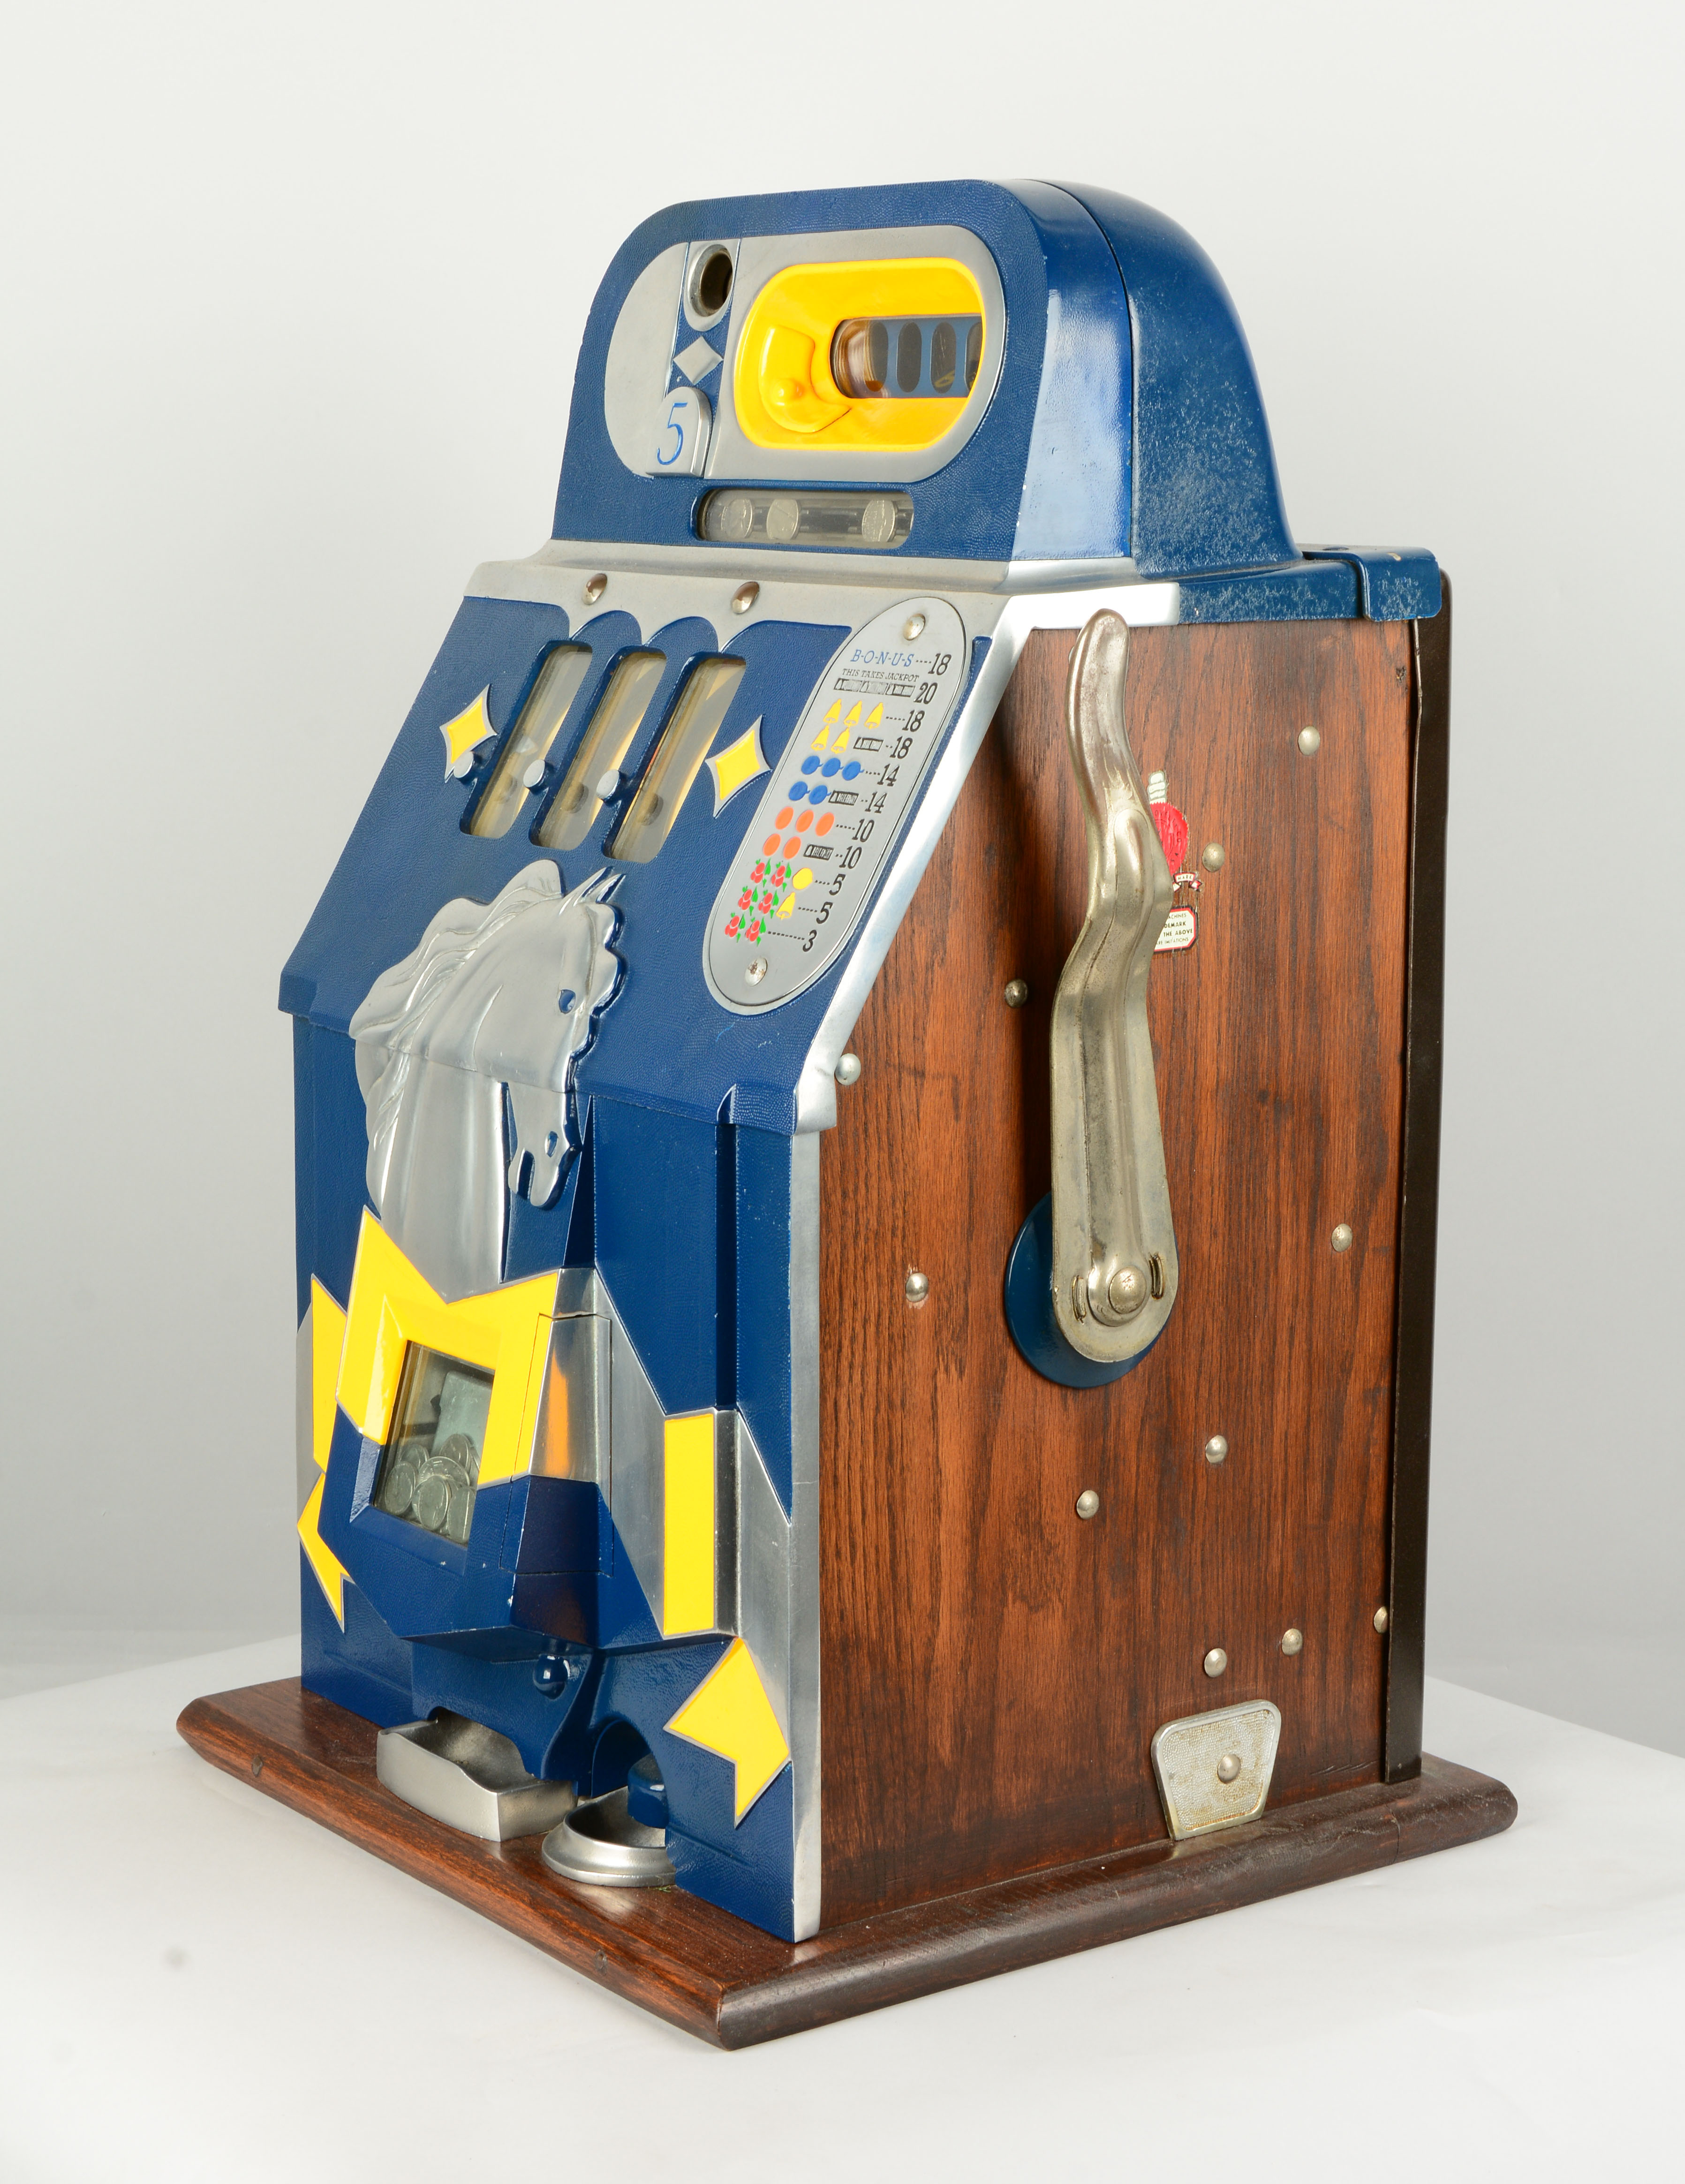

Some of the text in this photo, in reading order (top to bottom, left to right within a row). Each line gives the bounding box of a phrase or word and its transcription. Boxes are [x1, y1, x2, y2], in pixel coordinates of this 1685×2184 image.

[657, 402, 688, 465] 5
[928, 653, 952, 675] 18
[861, 671, 884, 679] TAKES
[885, 673, 920, 682] JACKPOT
[914, 682, 938, 705] 20
[902, 710, 925, 732] 18
[890, 736, 913, 759] 18
[877, 763, 900, 787] 14
[865, 791, 887, 814] 14
[852, 819, 875, 842] 10
[839, 846, 862, 869] 10
[829, 873, 846, 895] 5
[816, 902, 833, 924] 5
[802, 930, 817, 952] 3
